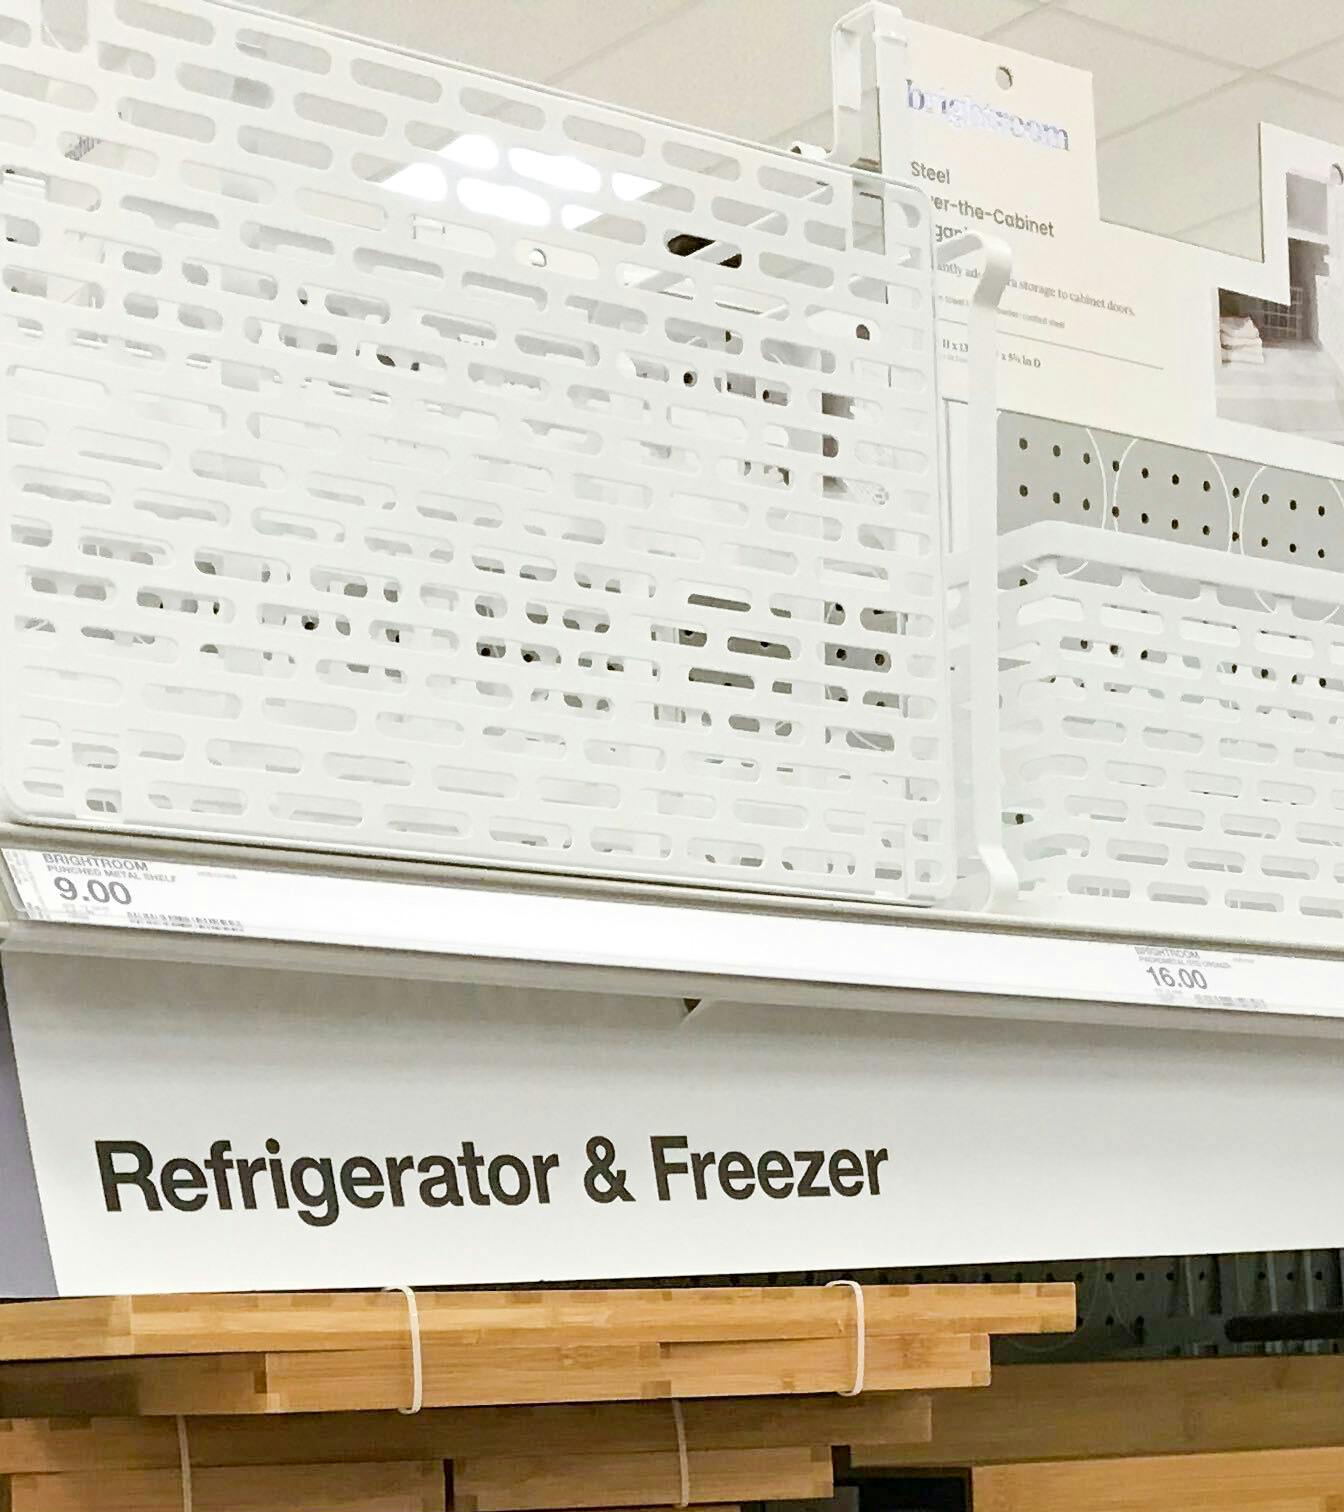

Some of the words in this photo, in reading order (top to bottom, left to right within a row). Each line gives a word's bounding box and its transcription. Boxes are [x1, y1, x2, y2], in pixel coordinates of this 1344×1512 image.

[911, 160, 950, 185] Steel
[931, 195, 1055, 238] er-the-Cabinet
[42, 852, 148, 872] BRIGHTROOM
[54, 876, 132, 906] 9.00
[1146, 965, 1208, 990] 16.00
[95, 1137, 560, 1228] Refrigerator
[583, 1135, 636, 1205] &
[650, 1135, 889, 1204] Freezer
